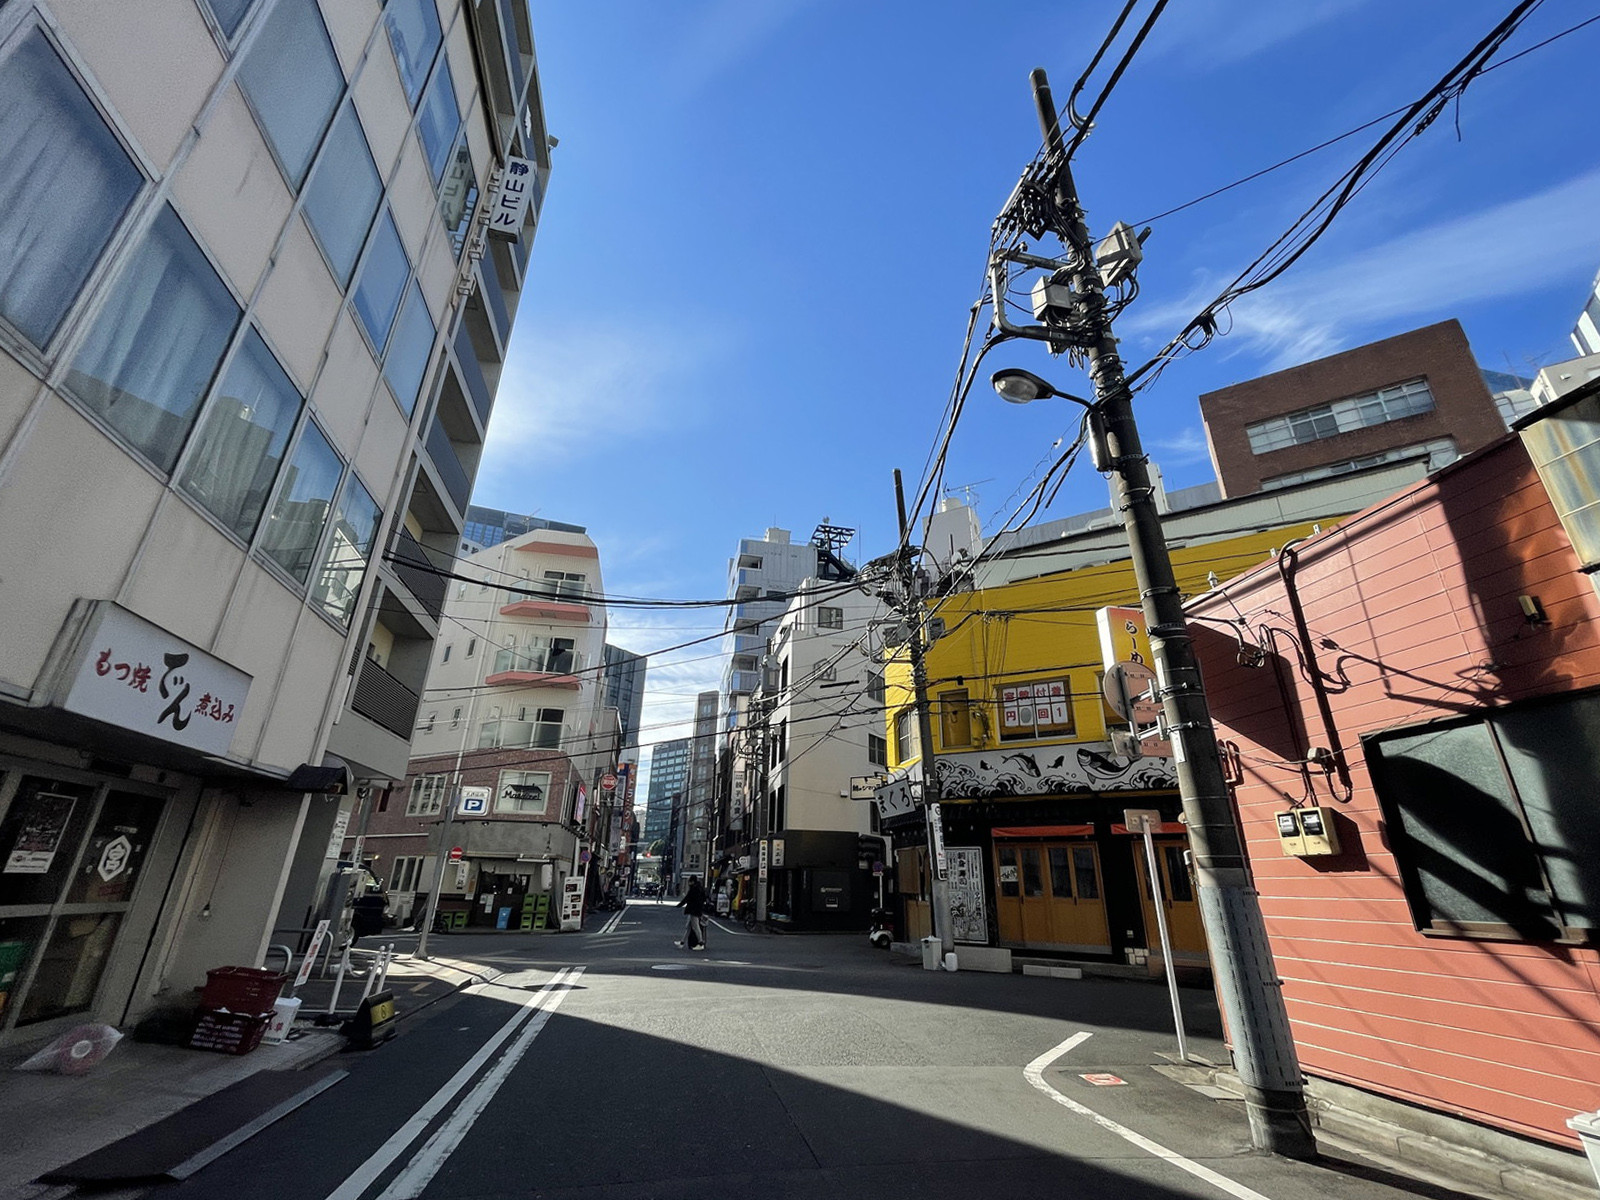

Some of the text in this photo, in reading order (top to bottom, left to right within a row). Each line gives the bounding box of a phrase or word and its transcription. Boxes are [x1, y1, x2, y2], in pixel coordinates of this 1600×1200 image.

[494, 161, 530, 226] 静山ビル
[95, 648, 235, 732] もつ焼 でん 煮込み
